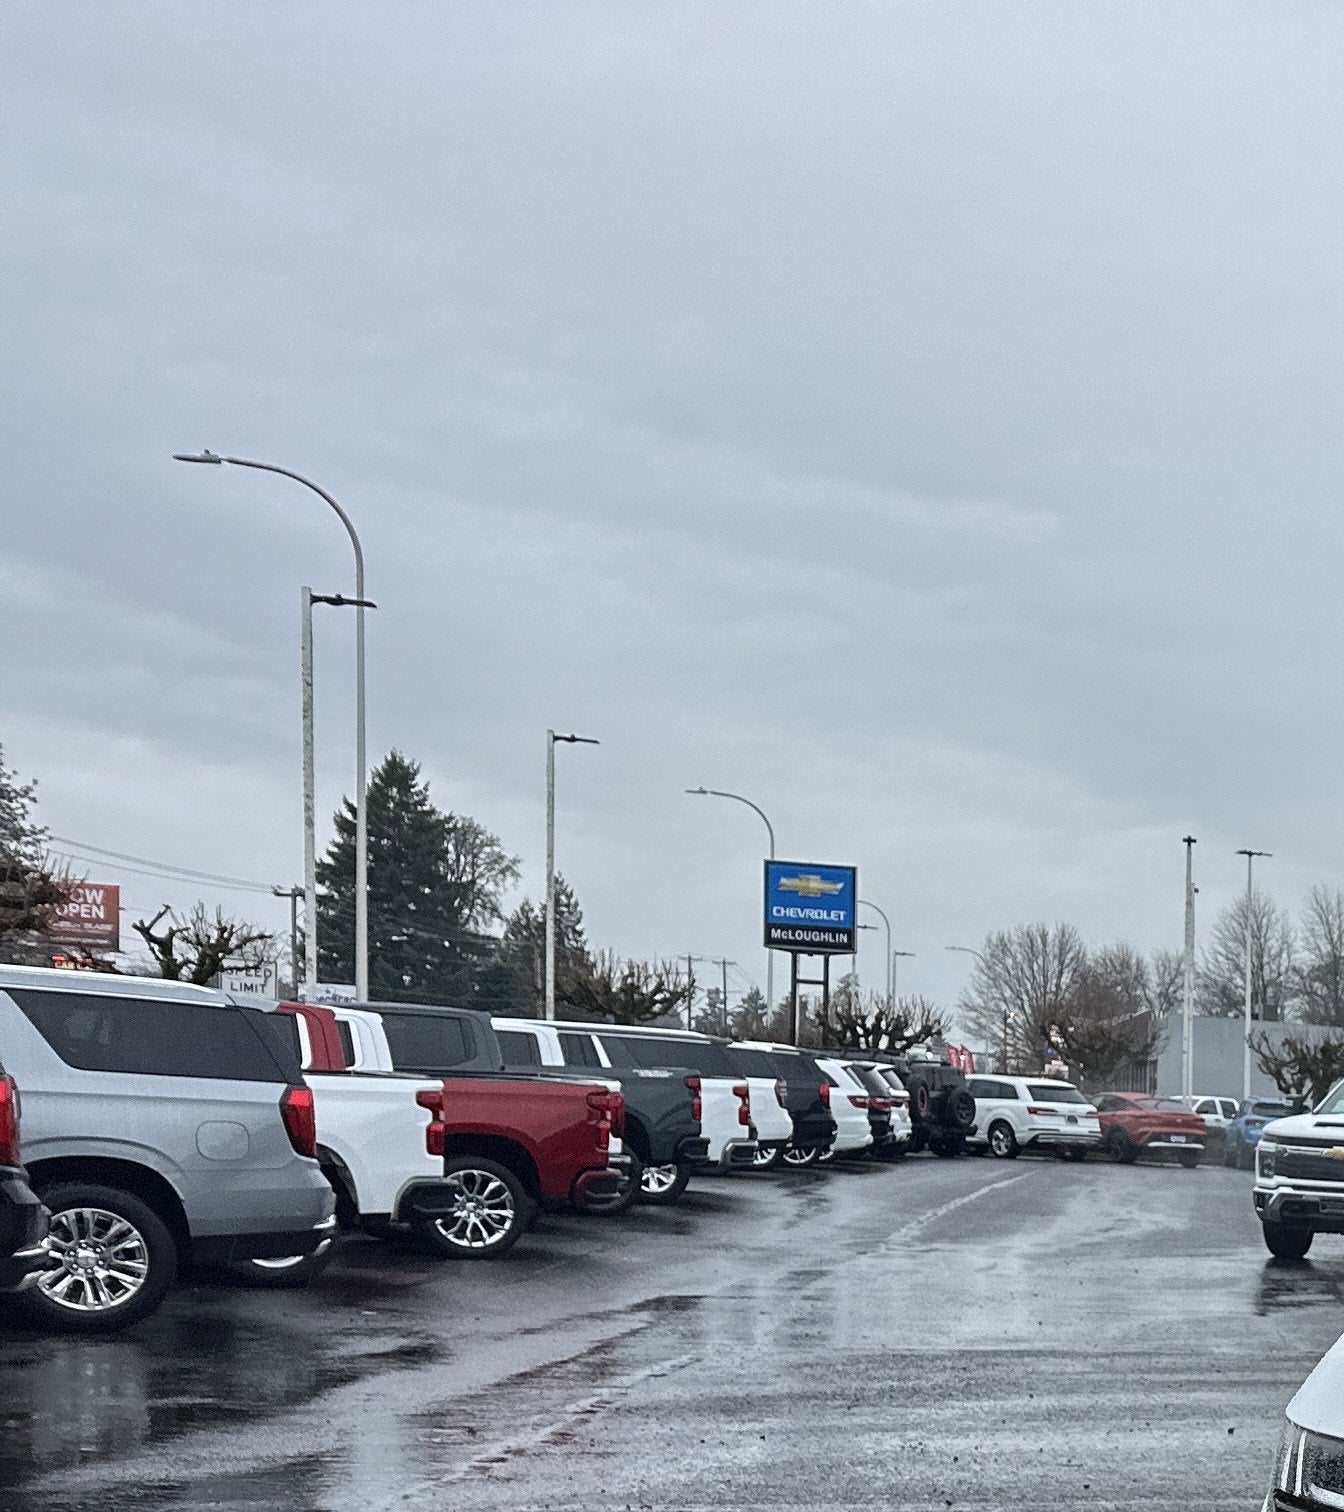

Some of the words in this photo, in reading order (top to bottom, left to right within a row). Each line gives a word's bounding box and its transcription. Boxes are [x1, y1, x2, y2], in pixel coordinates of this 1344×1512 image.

[772, 906, 847, 921] CHEVROLET
[770, 928, 848, 943] McLOUGHLIN
[230, 981, 266, 994] LIMIT
